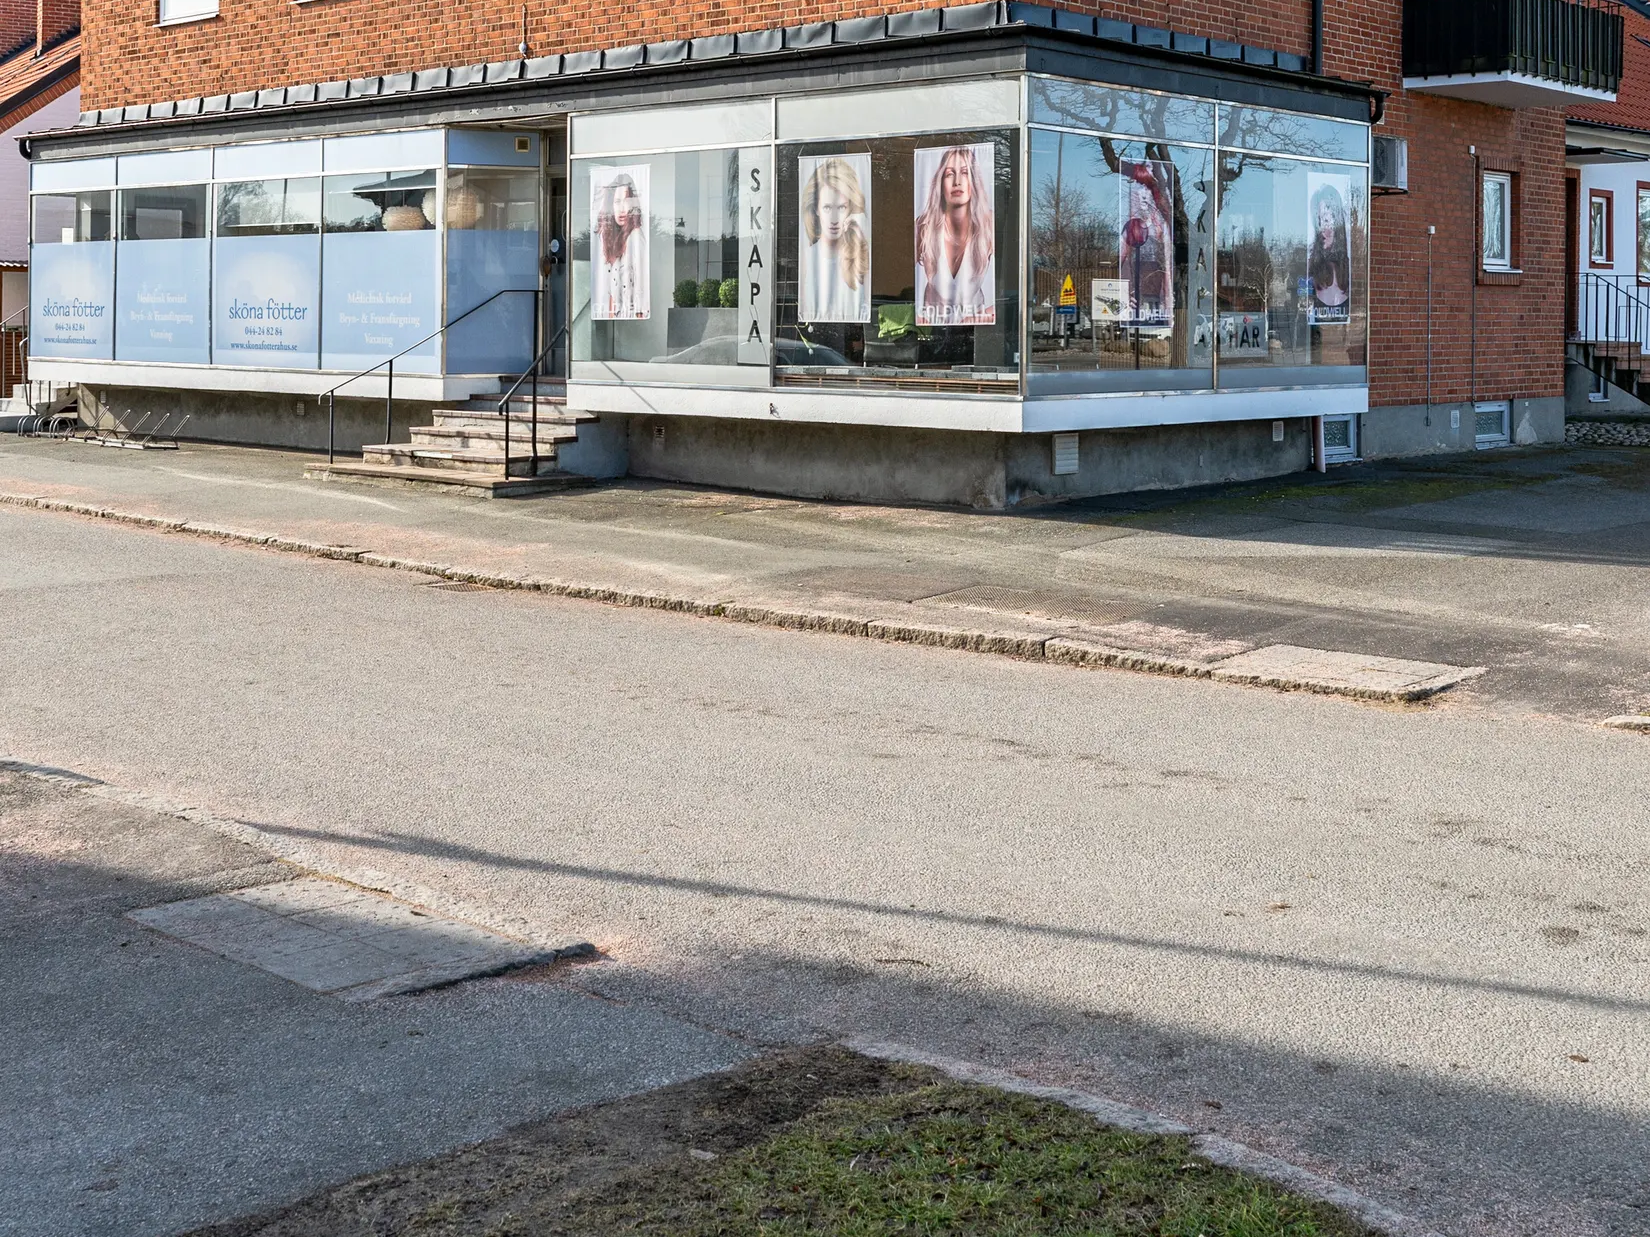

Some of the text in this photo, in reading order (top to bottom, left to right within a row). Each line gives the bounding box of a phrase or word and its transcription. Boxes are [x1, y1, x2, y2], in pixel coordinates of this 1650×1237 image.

[747, 167, 764, 344] SKAPA
[42, 297, 106, 318] sköna fötter
[228, 297, 308, 321] sköna fötter
[1120, 308, 1171, 321] OLDWELL
[244, 326, 283, 336] 044-24 82 84
